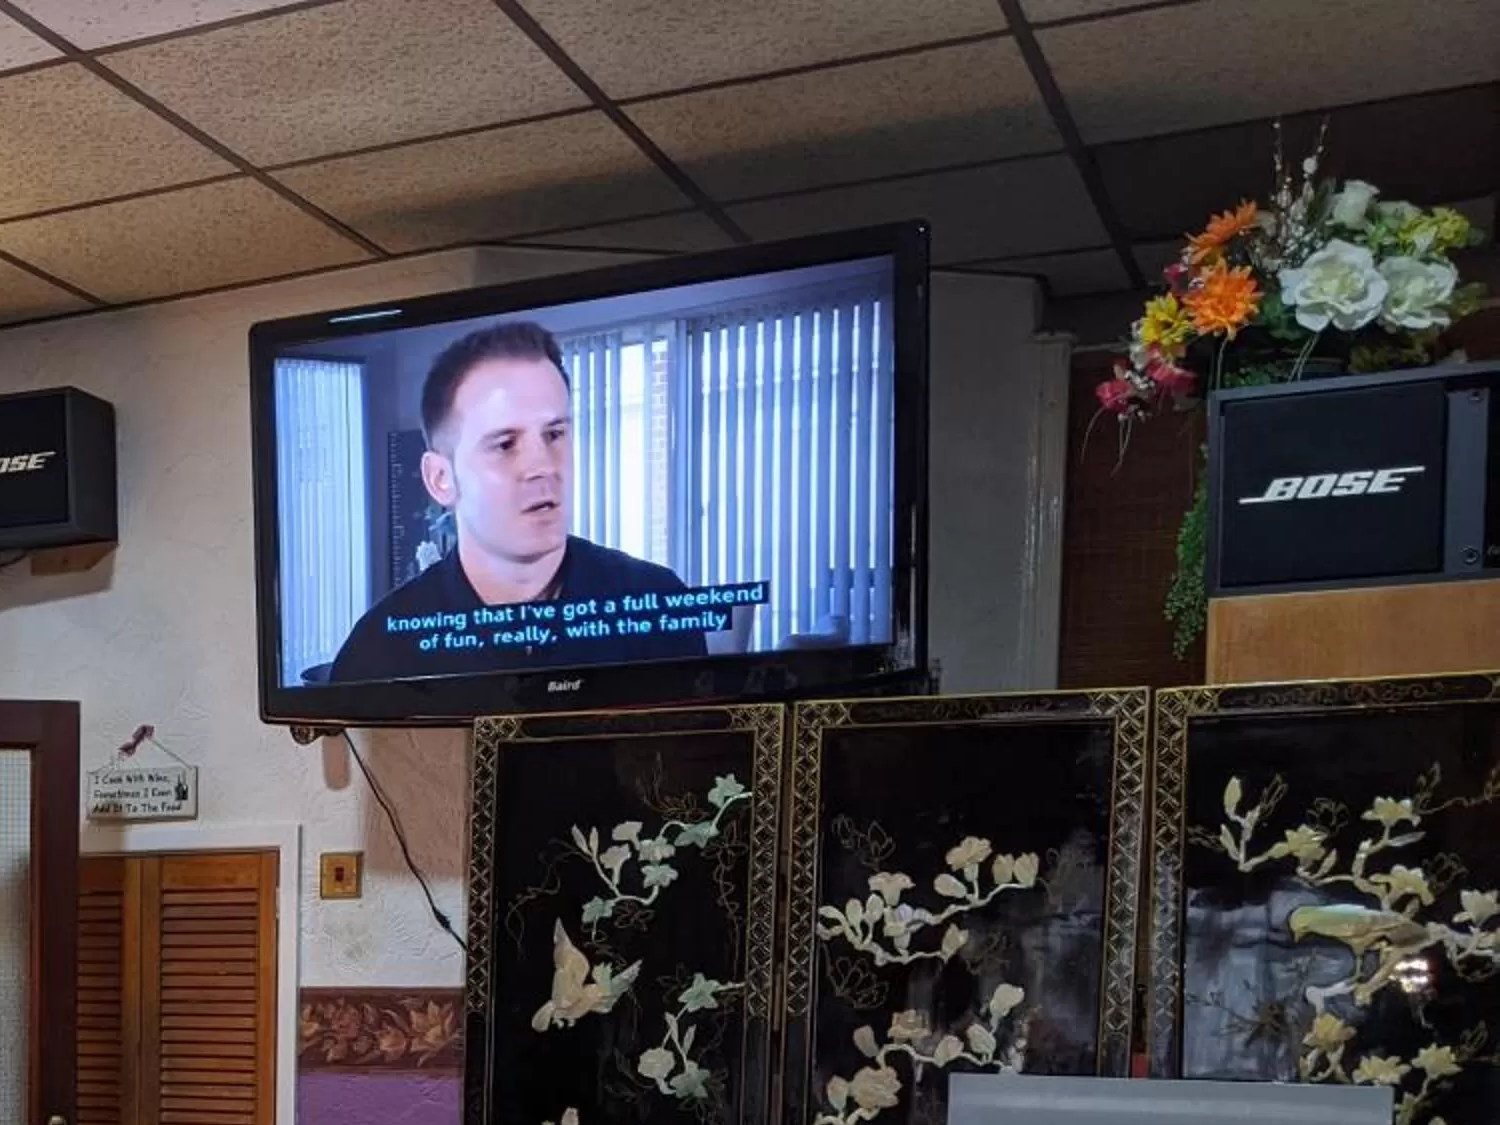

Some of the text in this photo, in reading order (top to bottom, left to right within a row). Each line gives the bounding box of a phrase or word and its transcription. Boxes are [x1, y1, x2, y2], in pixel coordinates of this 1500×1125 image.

[1238, 465, 1426, 505] BOSE
[387, 584, 764, 631] knowing that I've got a full weekend
[419, 611, 727, 650] of fun, really, with the family
[548, 679, 581, 692] Baird
